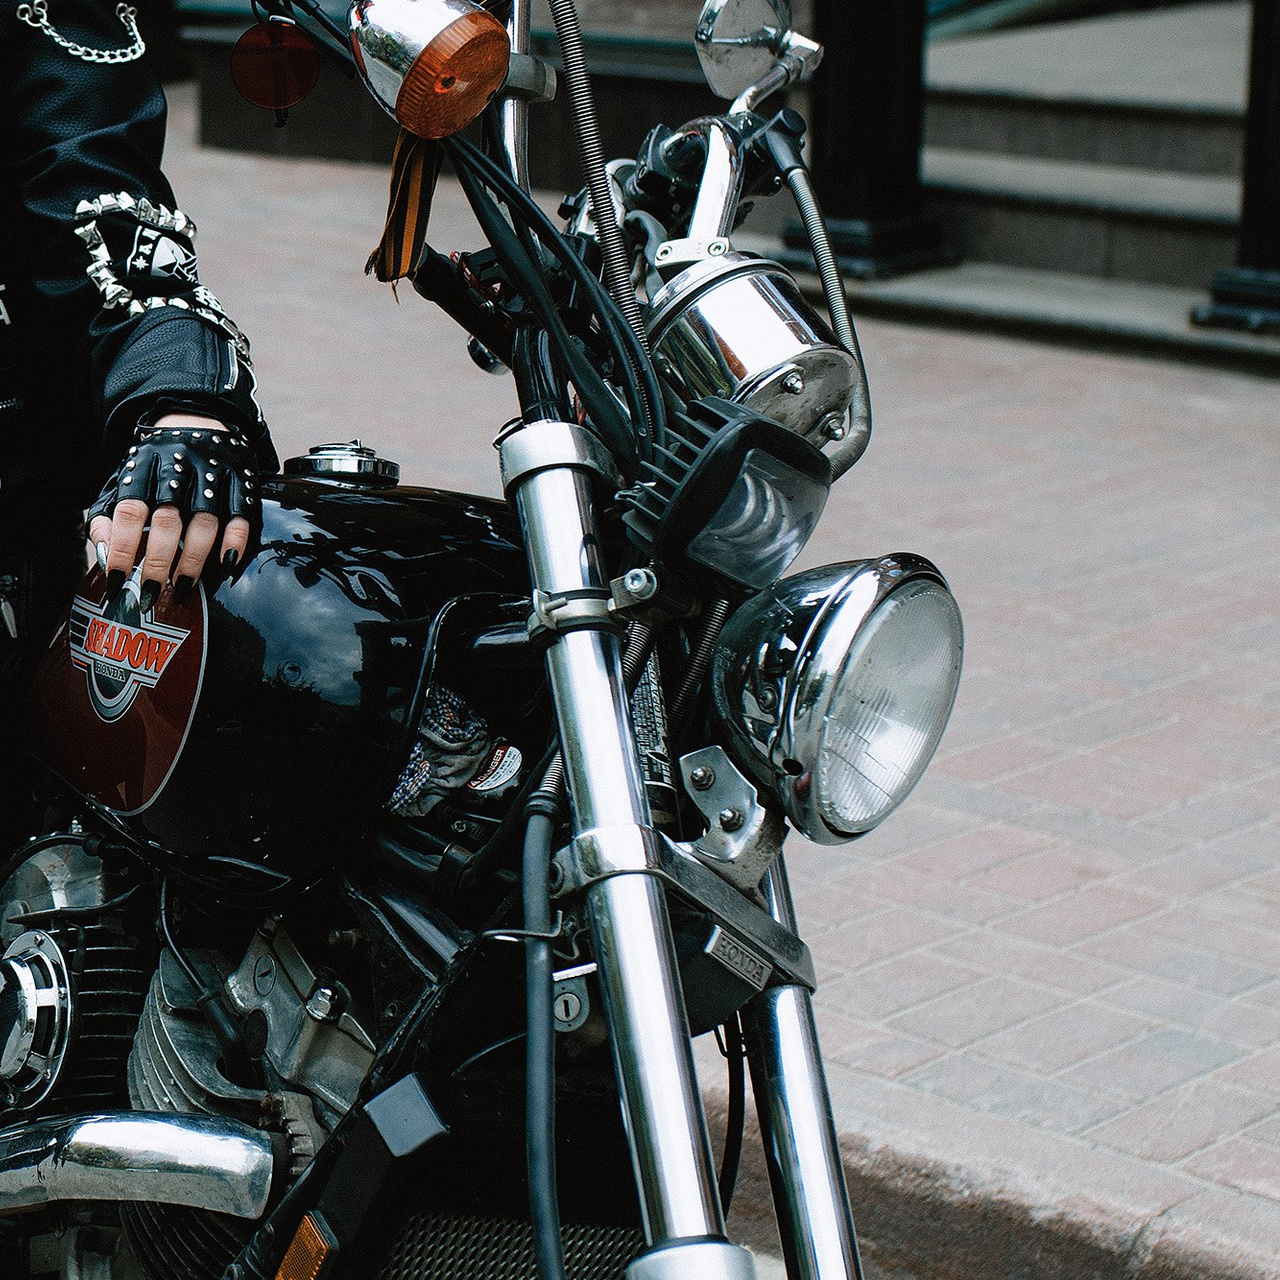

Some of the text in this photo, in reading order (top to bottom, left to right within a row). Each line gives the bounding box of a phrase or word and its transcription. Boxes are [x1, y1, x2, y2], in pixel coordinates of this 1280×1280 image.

[84, 617, 178, 673] SHADOW
[94, 661, 126, 682] HONDA
[477, 749, 504, 783] DANGER
[718, 936, 764, 982] HONDA
